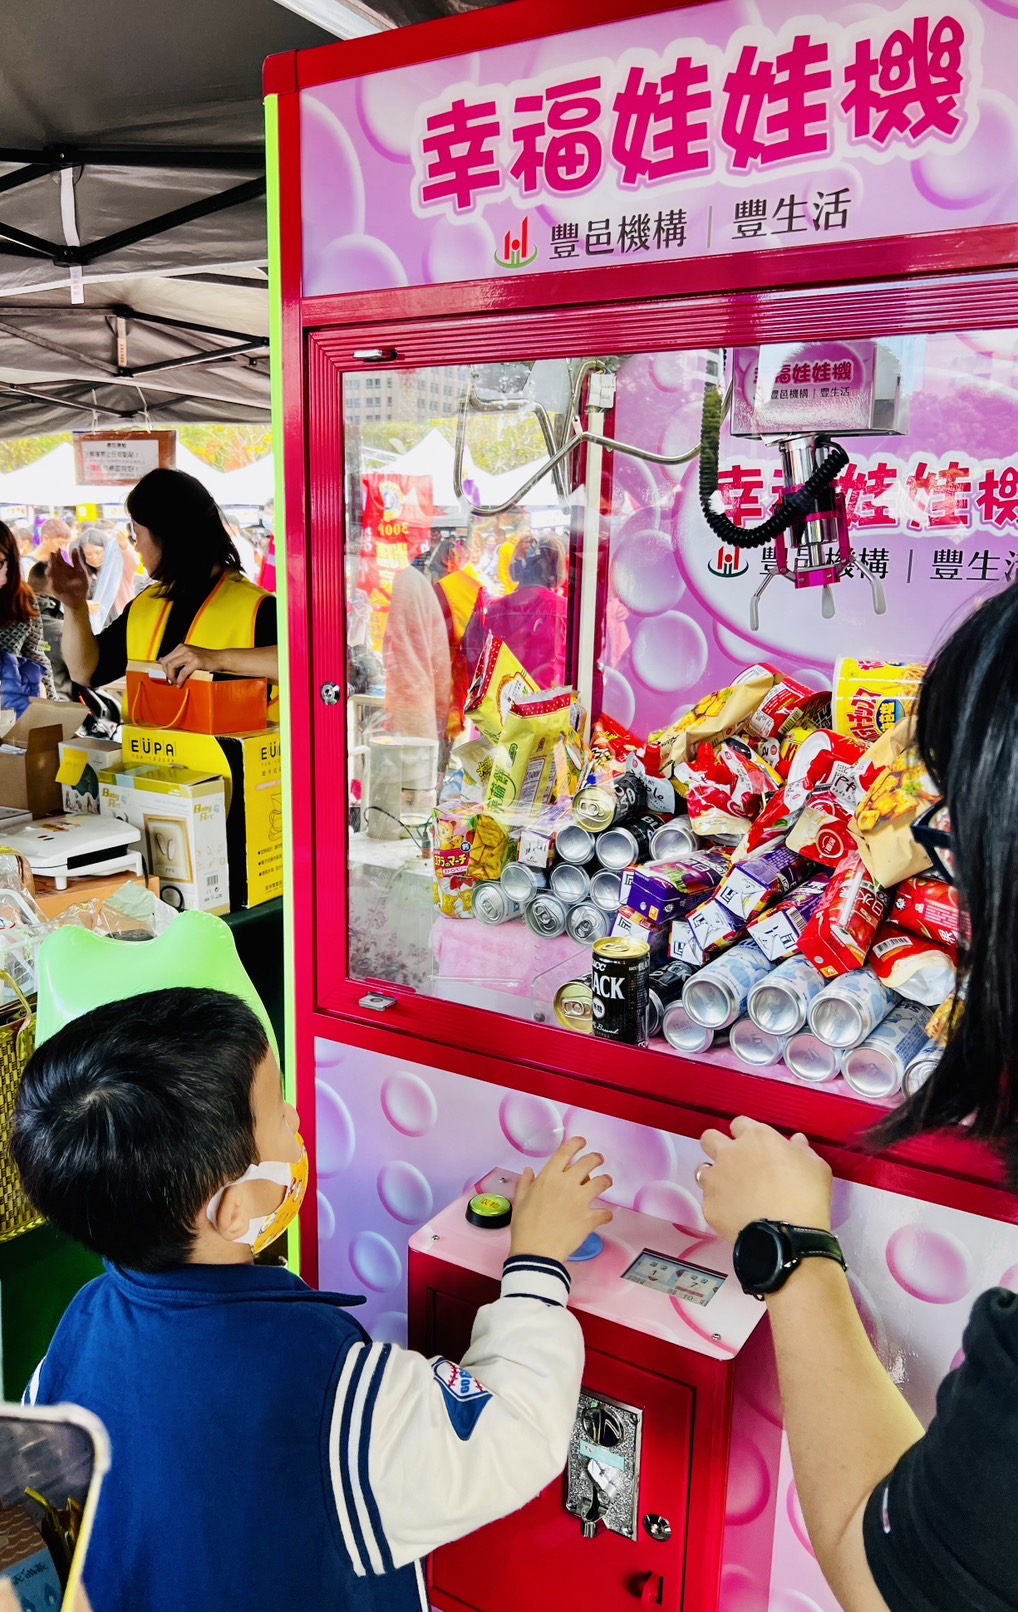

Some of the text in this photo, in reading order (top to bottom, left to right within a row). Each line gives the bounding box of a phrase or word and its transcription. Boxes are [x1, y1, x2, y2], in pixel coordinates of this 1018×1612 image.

[421, 15, 965, 209] 幸福娃娃機
[549, 188, 851, 261] 豐邑機構 豐生活
[753, 361, 852, 384] 福娃娃機
[261, 741, 281, 761] EÜ
[102, 787, 120, 800] Baby
[193, 803, 212, 815] Baby
[592, 971, 626, 1000] ACK
